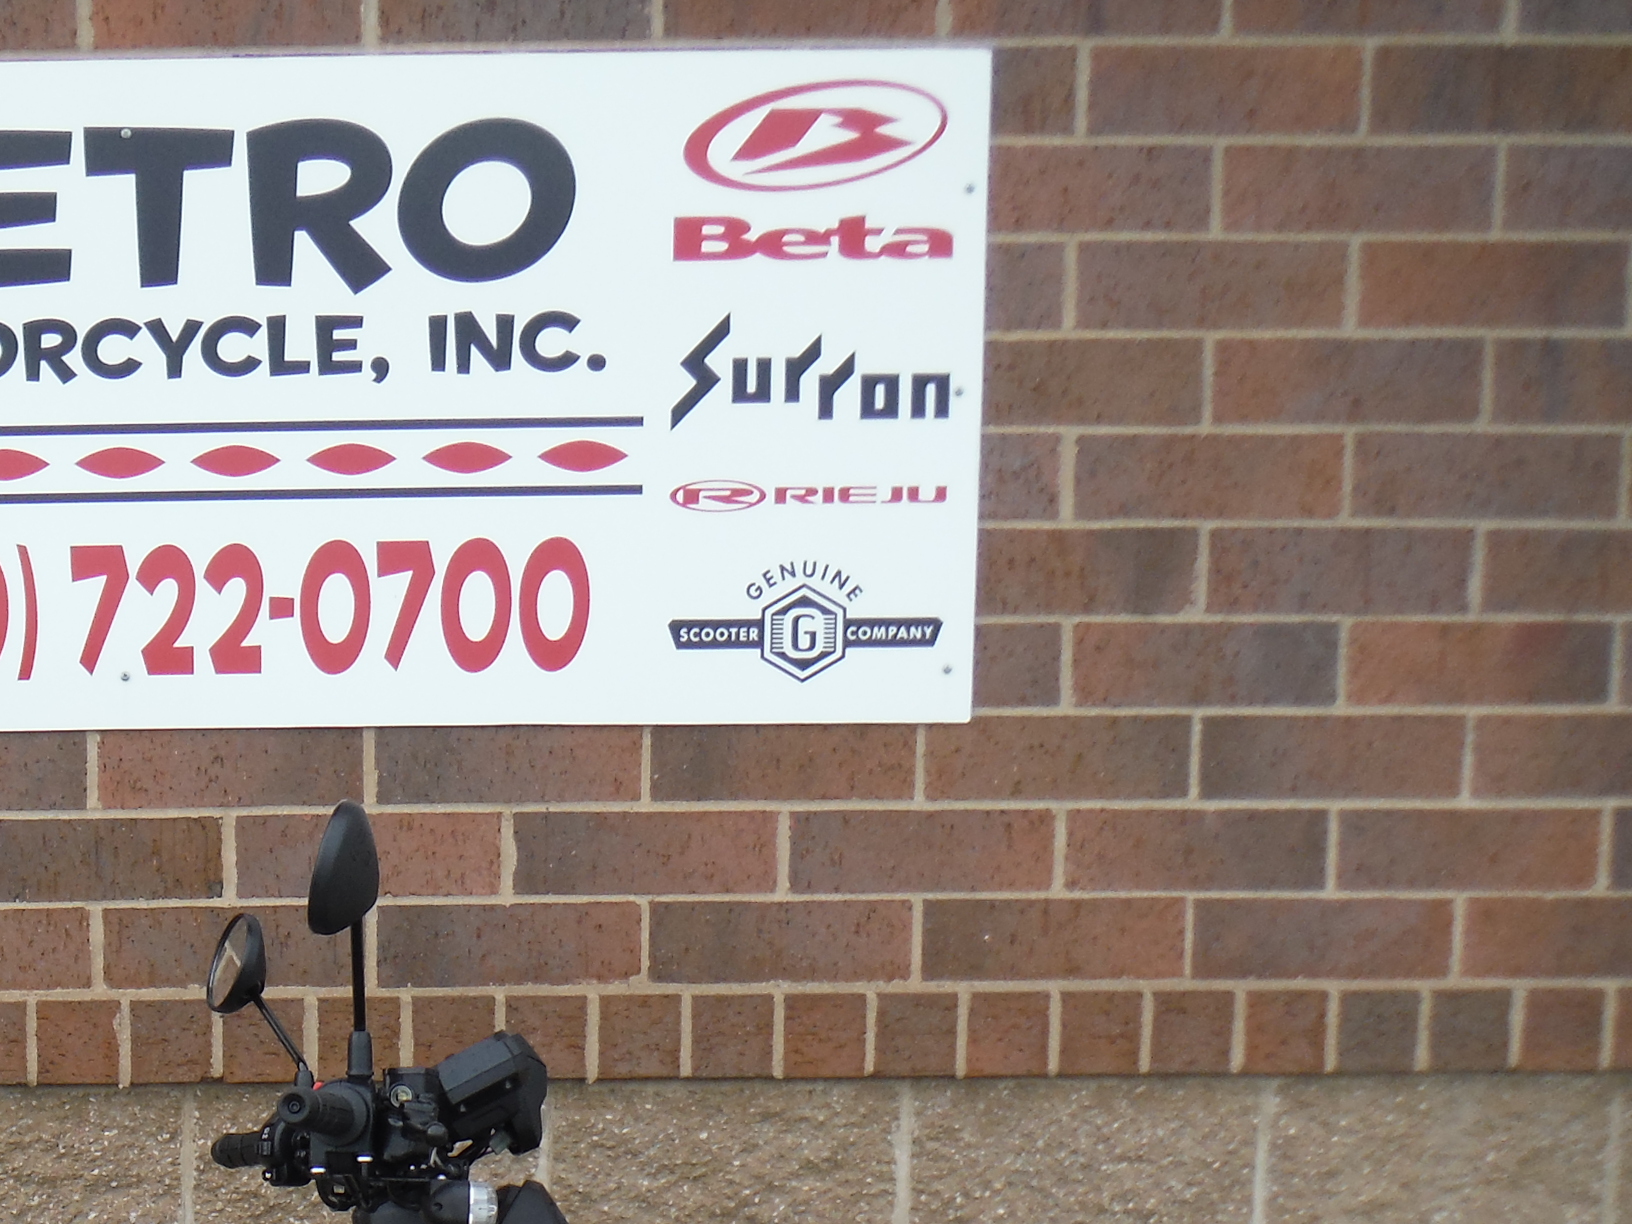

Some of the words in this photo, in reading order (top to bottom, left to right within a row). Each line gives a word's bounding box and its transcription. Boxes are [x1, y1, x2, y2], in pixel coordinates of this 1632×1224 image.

[673, 215, 954, 261] Beta
[429, 311, 607, 374] INC.
[670, 312, 951, 431] Surron
[774, 486, 948, 505] RIEJU
[745, 560, 864, 603] GENUINE
[70, 537, 590, 682] 722-0700
[678, 626, 760, 643] SCOOTER
[845, 623, 935, 642] COMPANY
